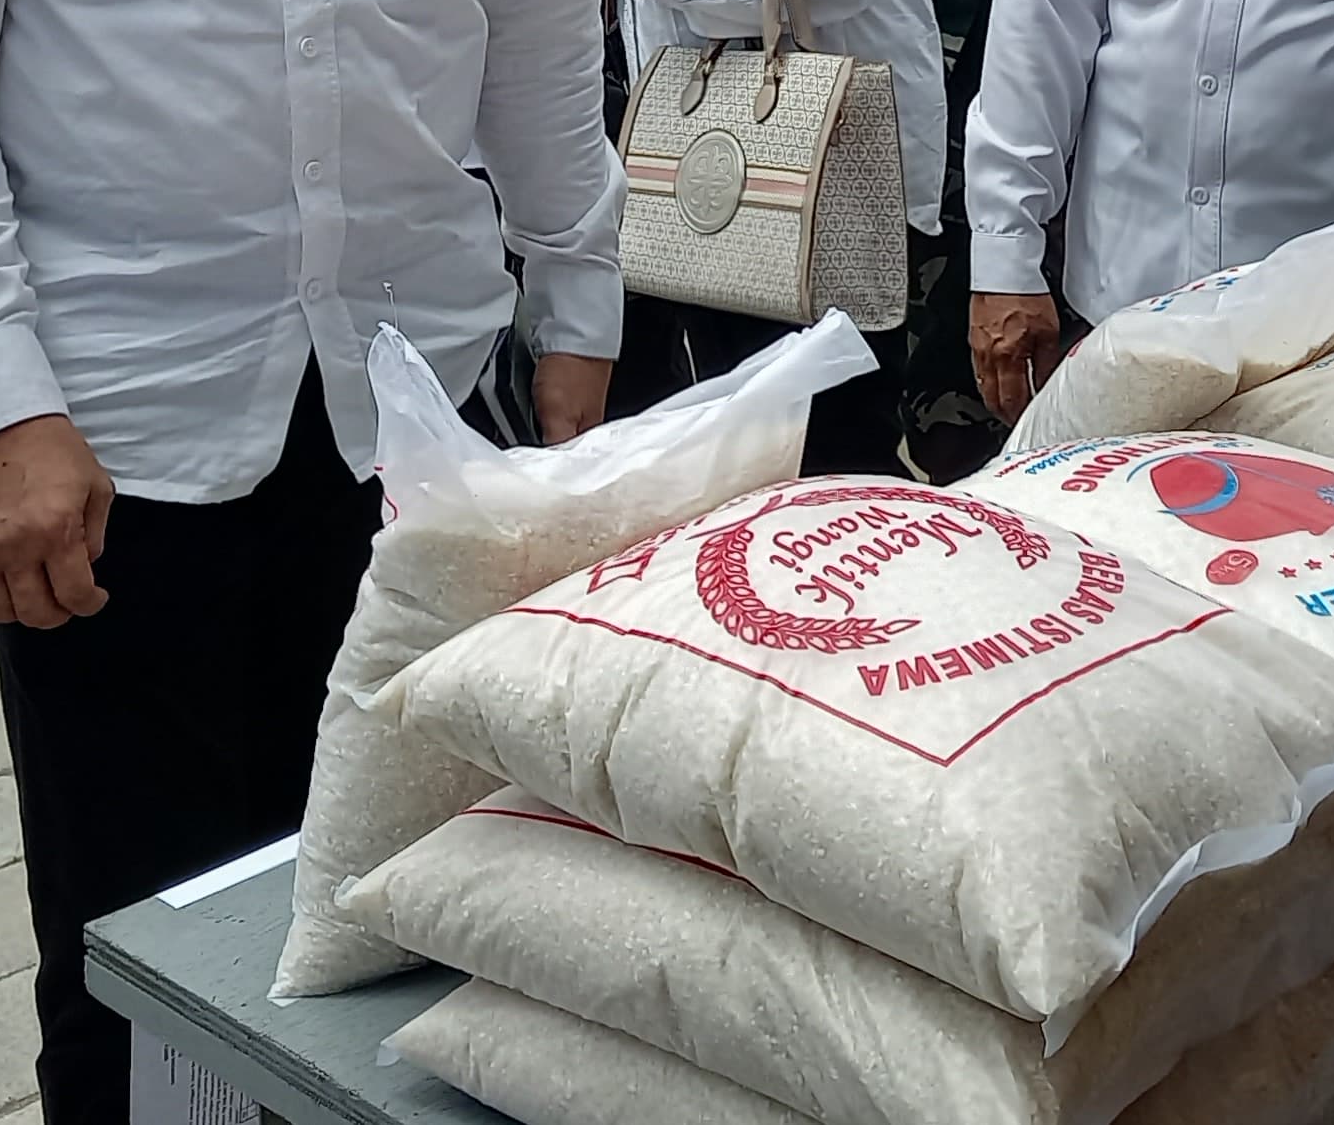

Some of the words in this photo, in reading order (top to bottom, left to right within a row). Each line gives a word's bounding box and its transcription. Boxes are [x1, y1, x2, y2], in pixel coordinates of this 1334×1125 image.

[768, 505, 909, 574] Wangi
[794, 512, 983, 615] Mentik
[1060, 550, 1125, 625] BERAS
[856, 613, 1085, 697] ISTIMEWA
